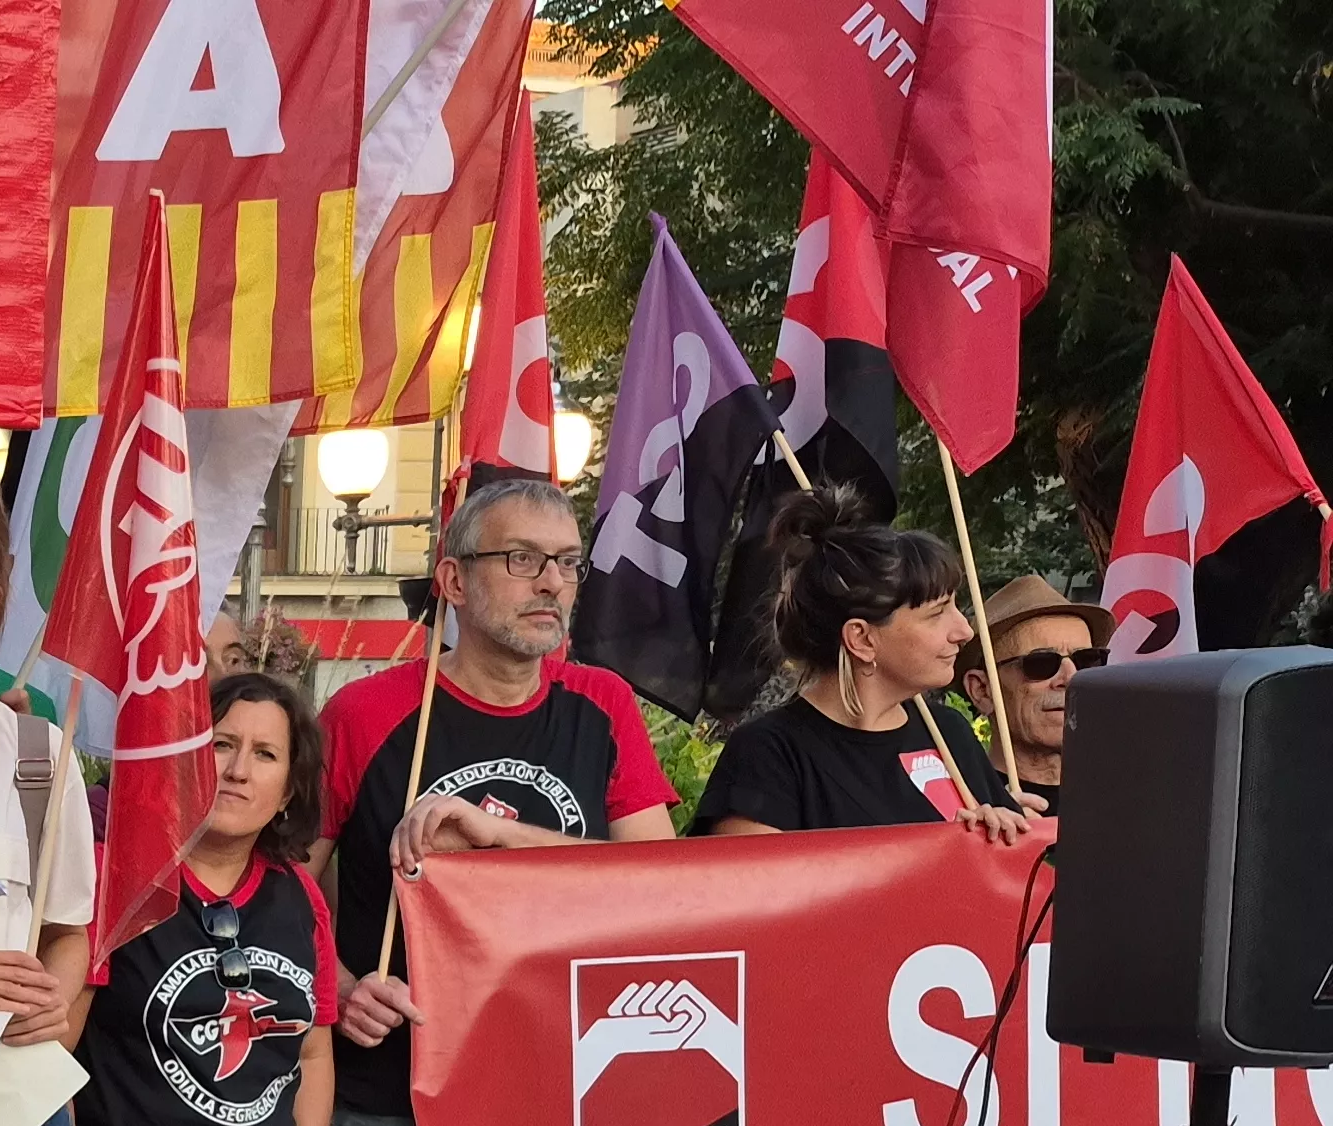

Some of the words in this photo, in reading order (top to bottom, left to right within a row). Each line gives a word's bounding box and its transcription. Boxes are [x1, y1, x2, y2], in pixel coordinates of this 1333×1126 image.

[191, 1015, 238, 1046] CGT
[163, 1058, 197, 1099] ODIA
[195, 1093, 215, 1115] LA
